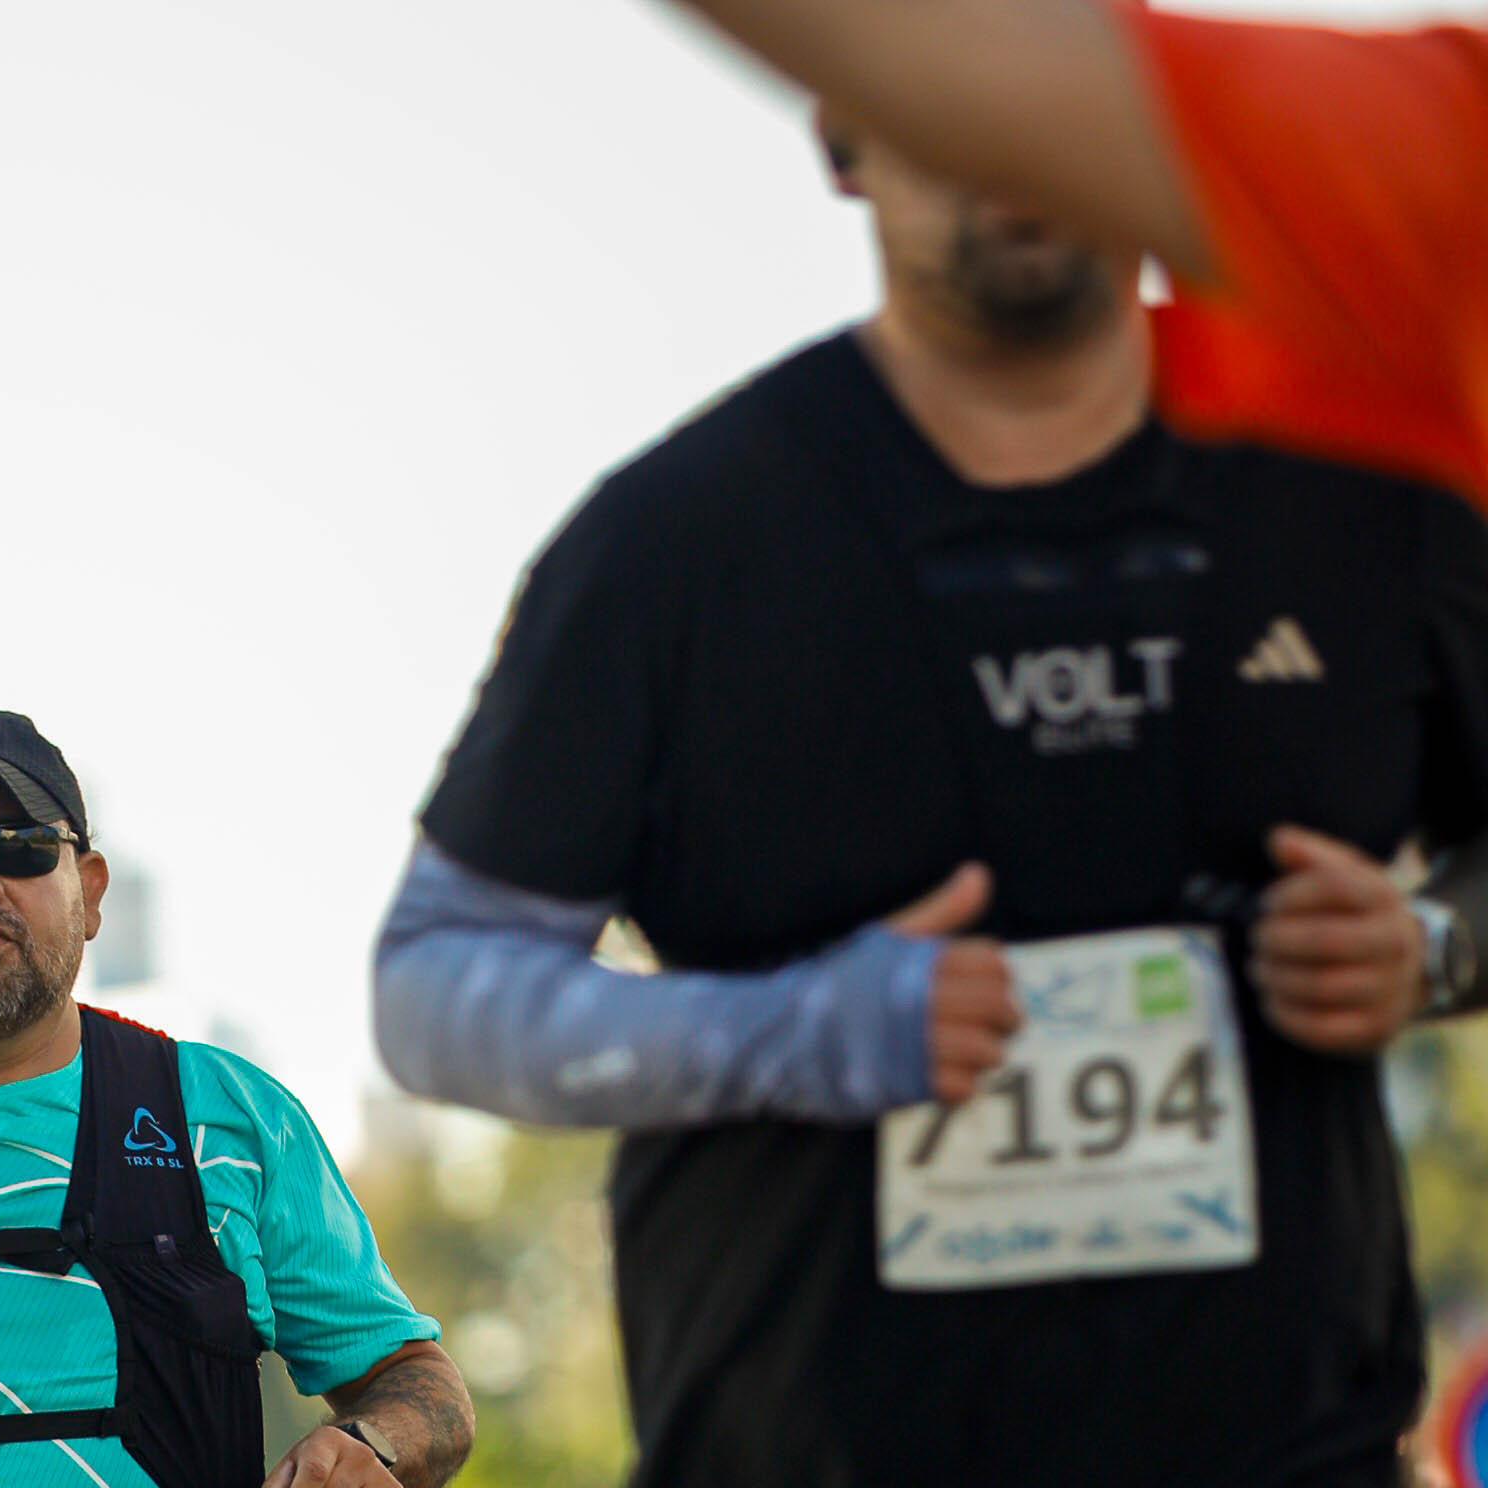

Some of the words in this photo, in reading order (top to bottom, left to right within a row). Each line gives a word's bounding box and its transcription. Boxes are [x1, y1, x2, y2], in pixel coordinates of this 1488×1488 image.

[972, 638, 1183, 728] VOLT
[124, 1155, 153, 1167] TRX
[167, 1157, 185, 1169] SL
